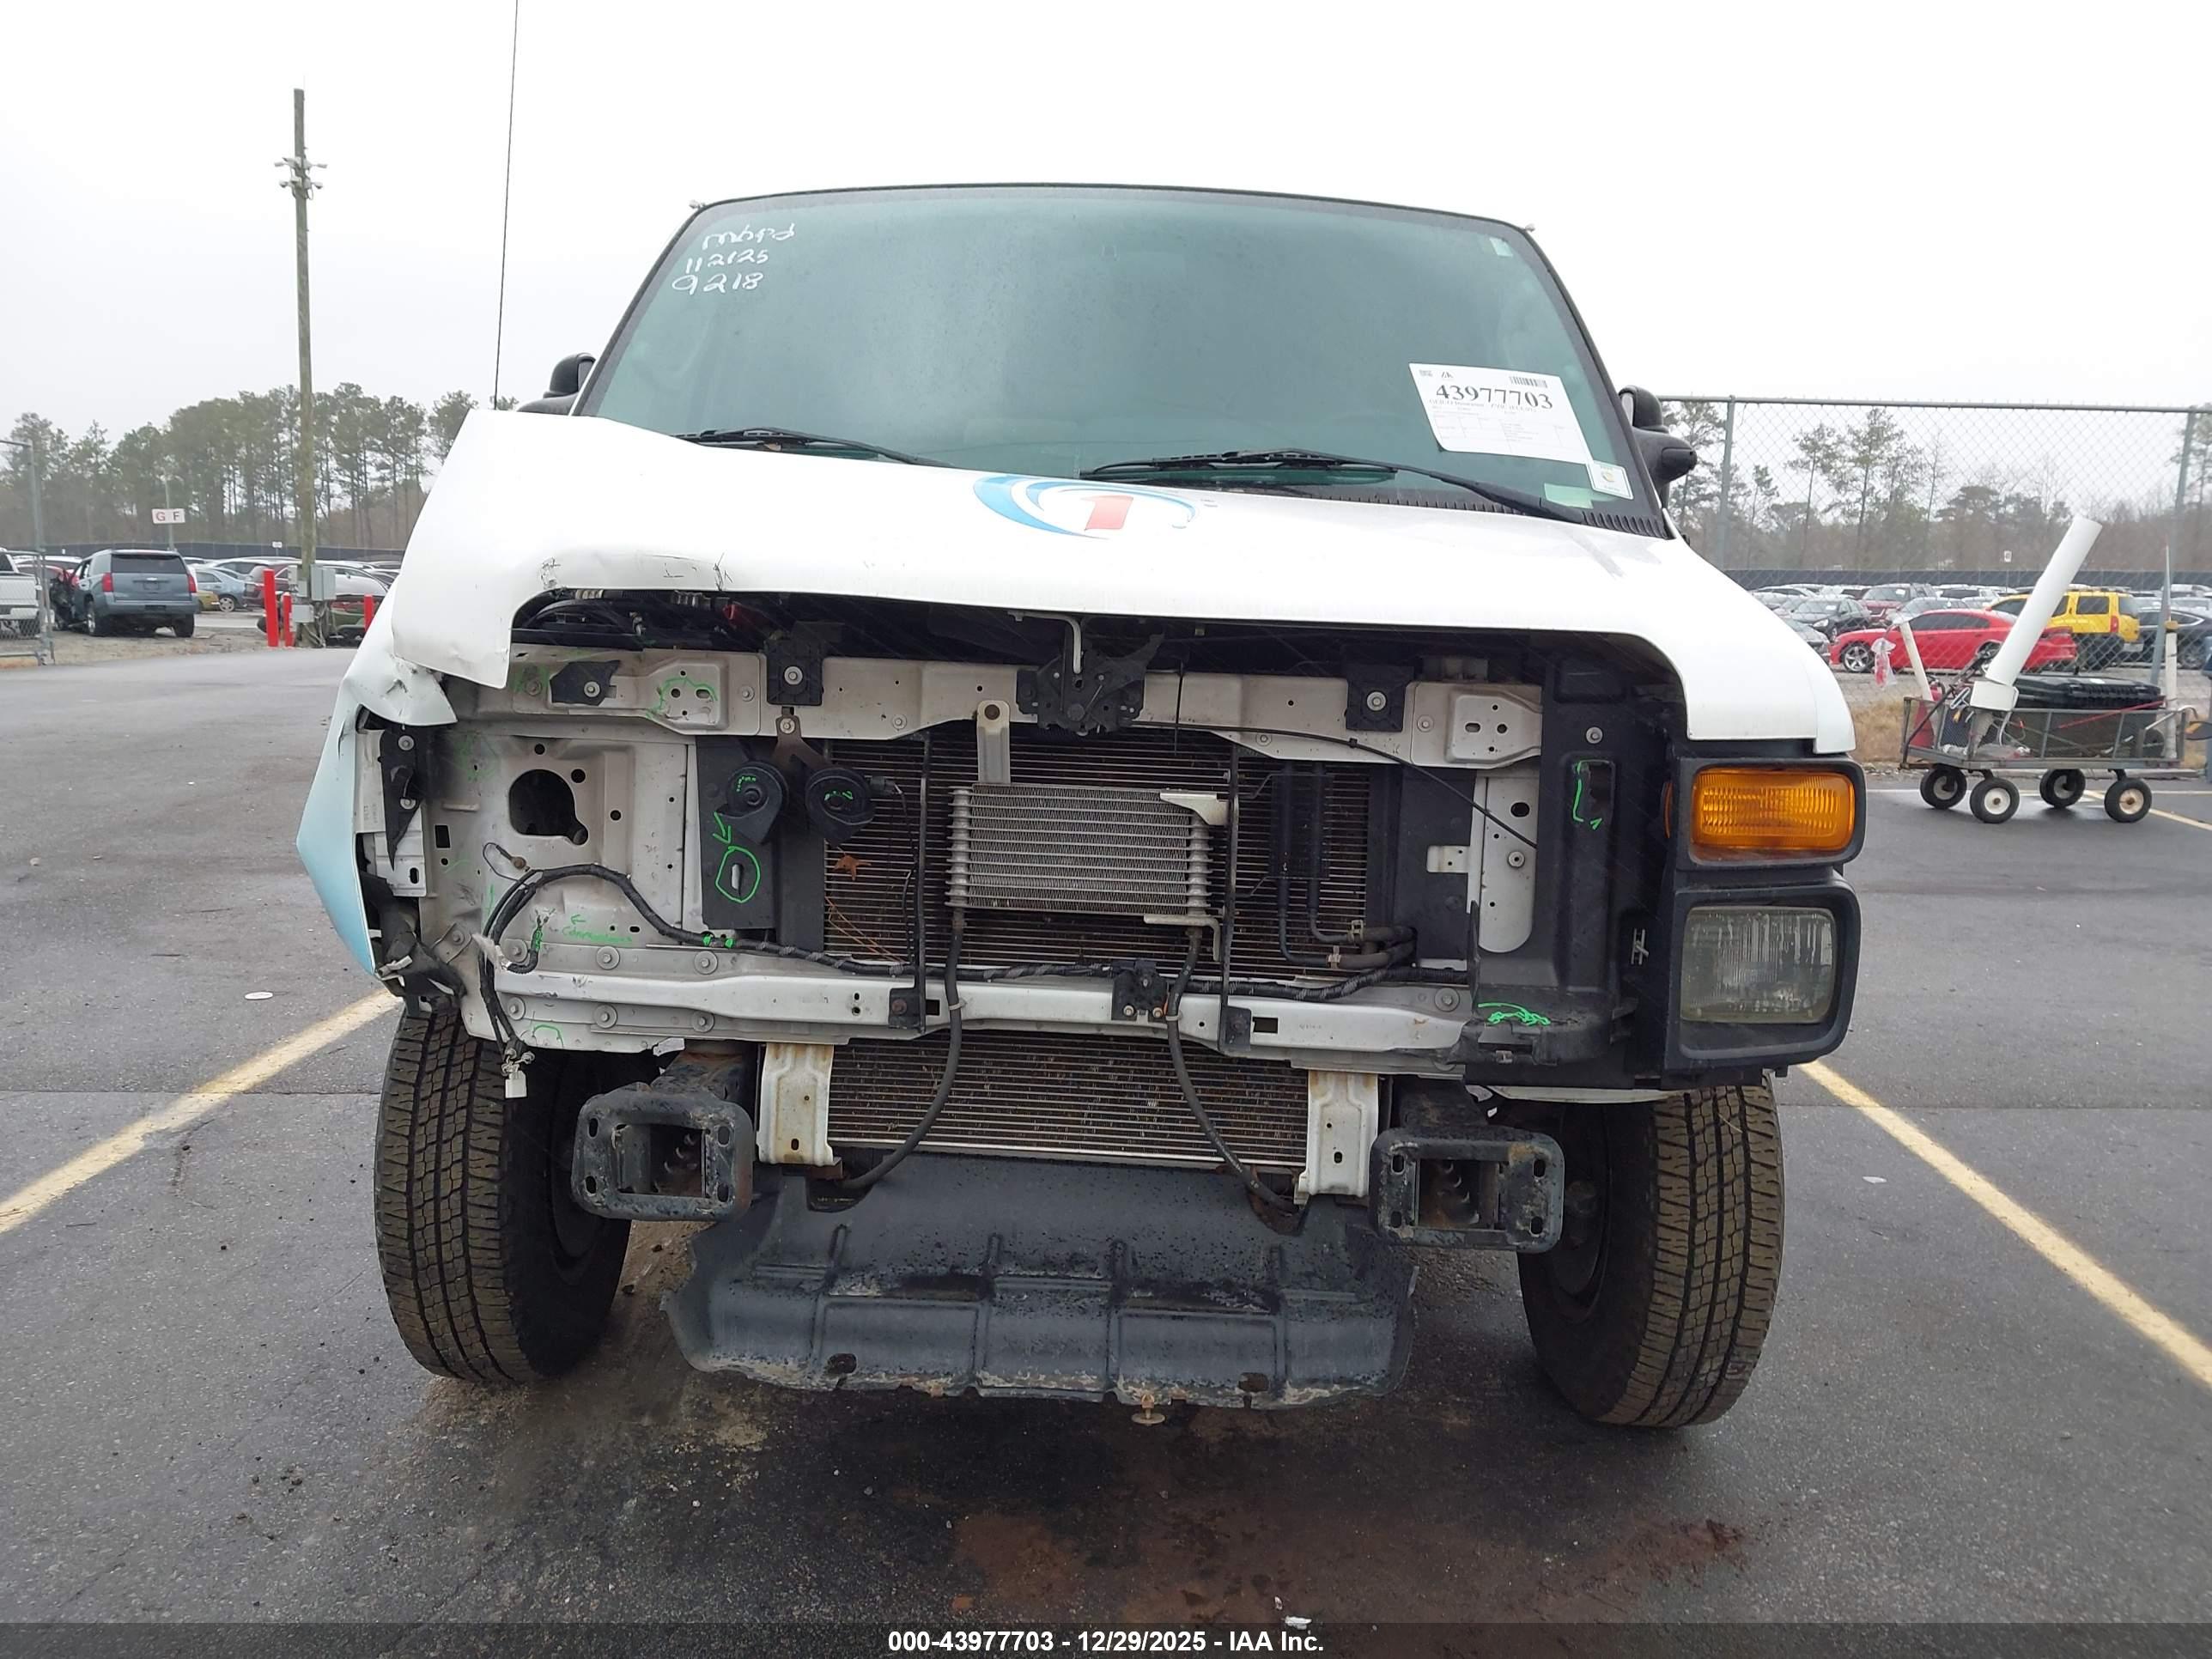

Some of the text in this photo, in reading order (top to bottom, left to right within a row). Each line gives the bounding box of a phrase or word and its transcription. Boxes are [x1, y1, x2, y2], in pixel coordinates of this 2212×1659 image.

[672, 271, 763, 295] 9218
[1436, 384, 1553, 410] 43977703
[155, 511, 179, 521] G F
